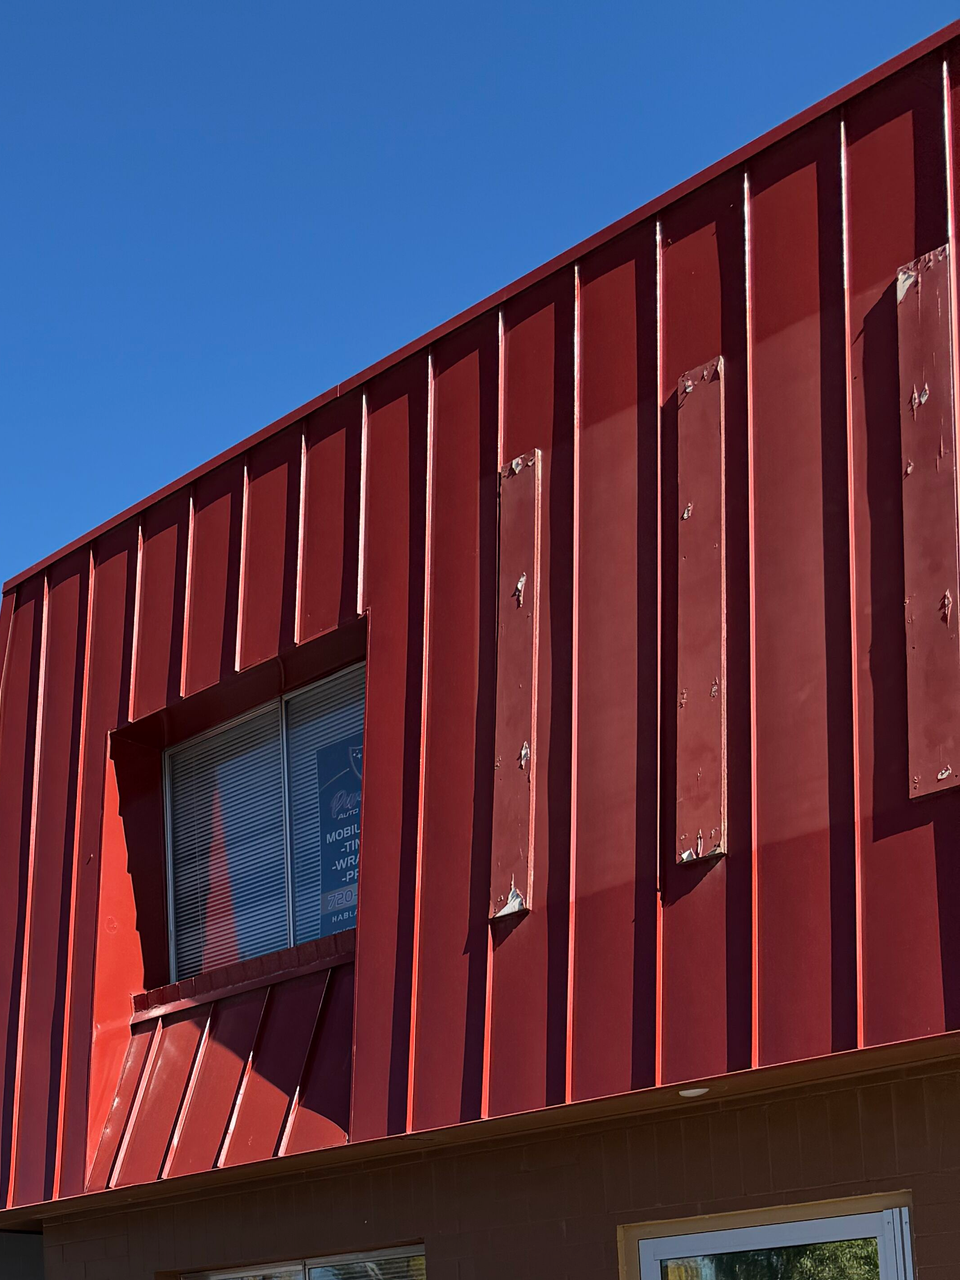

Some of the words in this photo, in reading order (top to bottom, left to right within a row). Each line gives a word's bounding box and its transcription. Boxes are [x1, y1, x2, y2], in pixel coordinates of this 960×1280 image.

[337, 808, 359, 820] AUTO
[326, 824, 361, 844] MOBIL
[340, 838, 360, 853] -TIN
[327, 889, 358, 910] 720-
